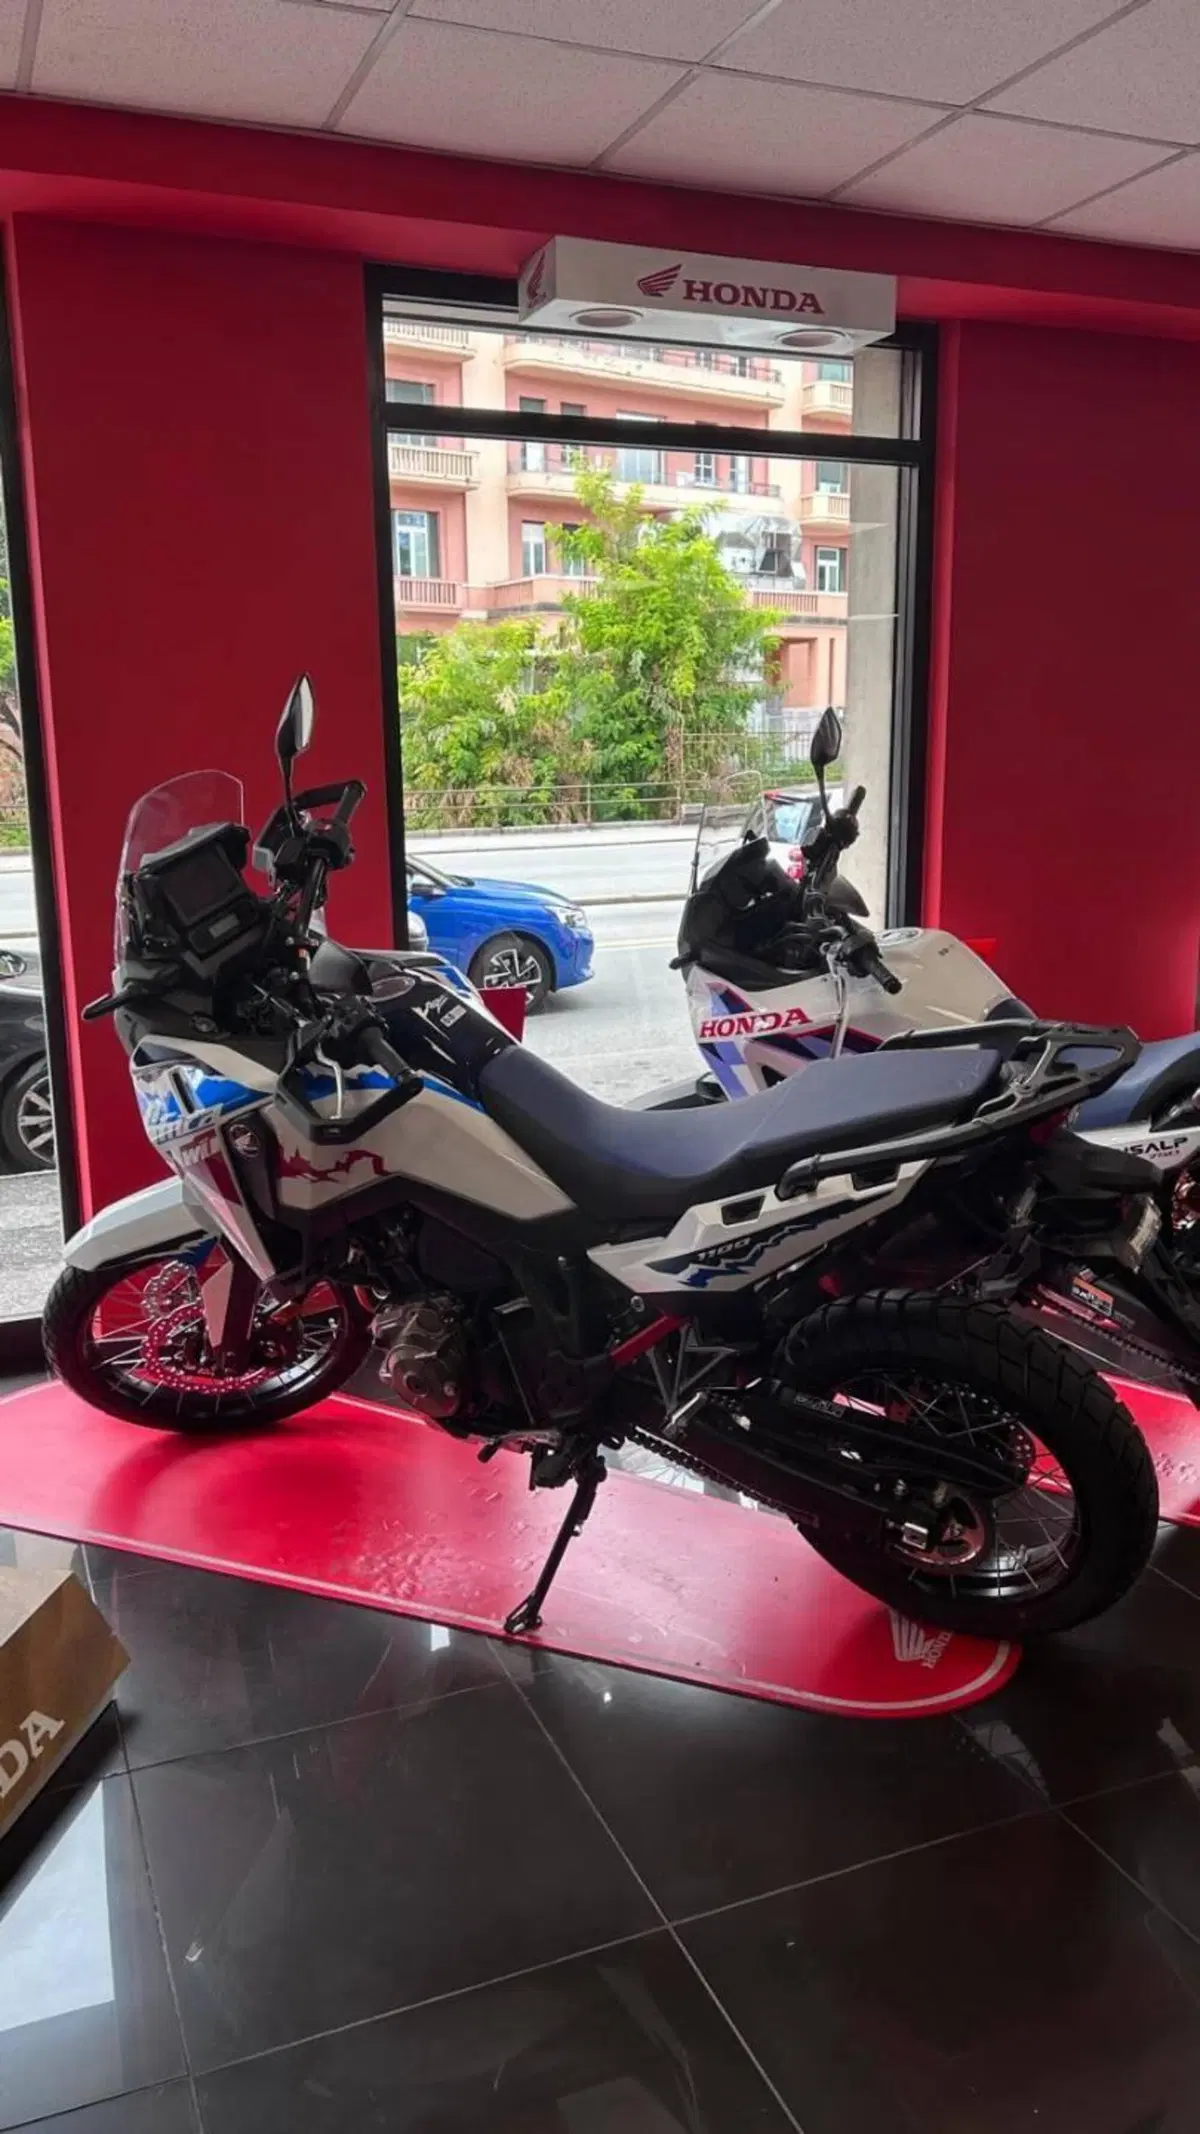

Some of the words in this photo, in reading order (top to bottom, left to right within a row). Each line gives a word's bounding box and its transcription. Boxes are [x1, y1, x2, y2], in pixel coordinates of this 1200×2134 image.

[682, 279, 825, 315] HONDA
[699, 1006, 813, 1039] HONDA
[1124, 1136, 1189, 1156] SALP
